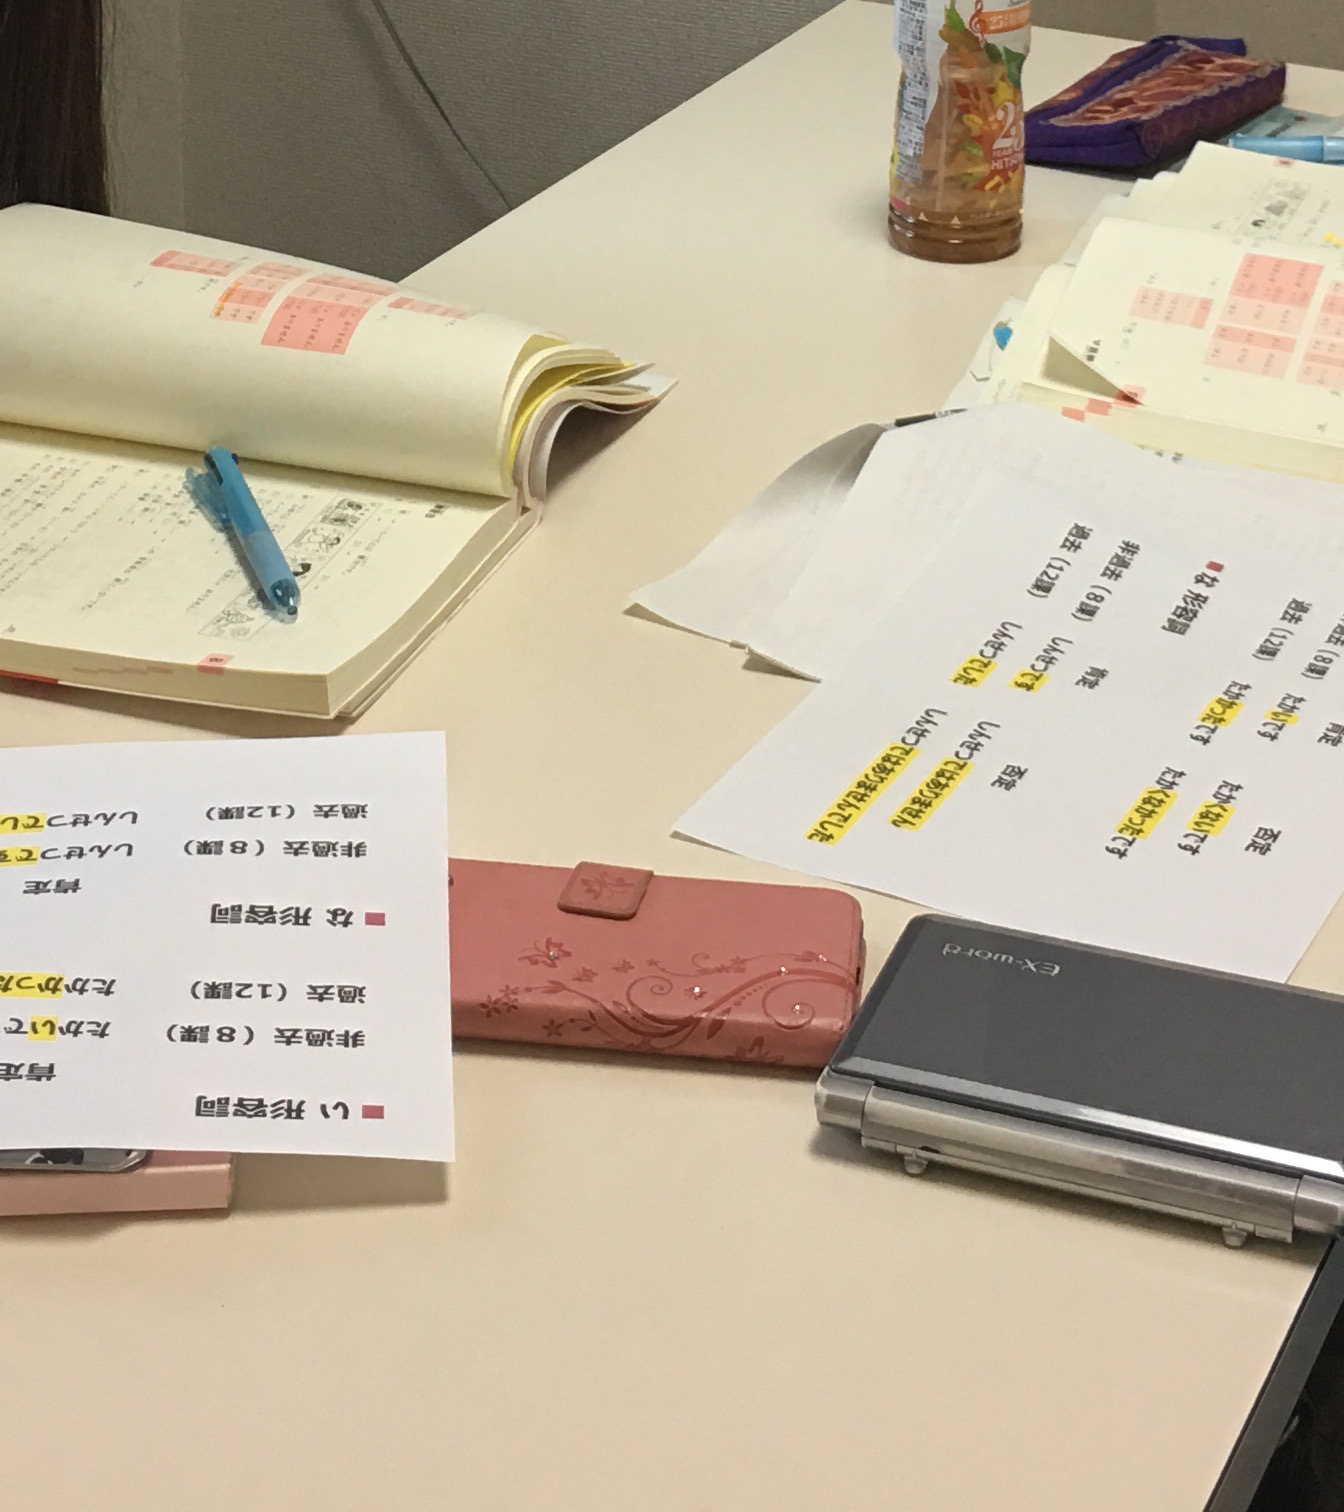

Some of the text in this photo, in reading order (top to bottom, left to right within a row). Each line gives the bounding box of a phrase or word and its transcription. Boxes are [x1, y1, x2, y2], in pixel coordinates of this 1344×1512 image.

[1160, 571, 1221, 636] な 形容詞
[953, 621, 1023, 686] しんせつでした
[1014, 636, 1073, 692] しんせつです
[990, 666, 1110, 792] 肯定 否定
[1189, 680, 1252, 747] たかかったです
[1257, 692, 1307, 742] たかいです
[807, 708, 948, 843] しんせつではありませんでした
[891, 720, 1001, 828] しんせつではありません
[1104, 766, 1188, 860] たかくなかったです
[1177, 780, 1244, 856] たかくないです
[1244, 826, 1282, 856] 否定
[22, 878, 82, 896] 肯定
[209, 903, 354, 929] な 形容詞
[941, 942, 1061, 977] EX-word
[194, 1095, 350, 1121] い 形容詞
